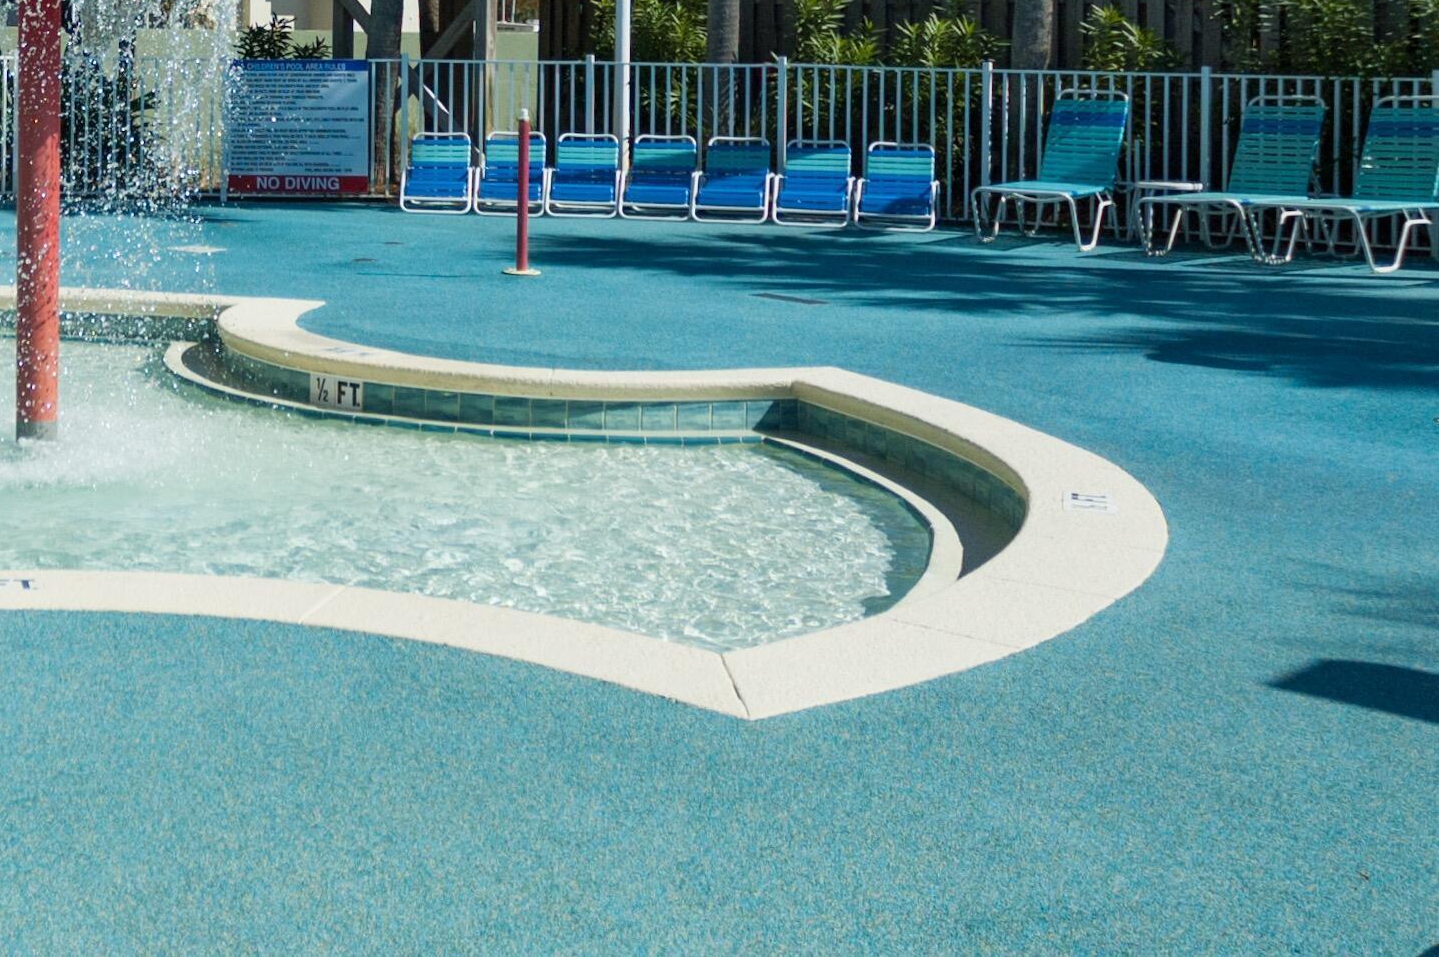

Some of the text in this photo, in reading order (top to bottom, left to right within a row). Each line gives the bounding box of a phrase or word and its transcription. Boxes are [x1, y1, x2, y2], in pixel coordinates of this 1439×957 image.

[286, 62, 304, 71] POOL
[305, 62, 322, 71] AREA
[256, 176, 341, 190] NO DIVING
